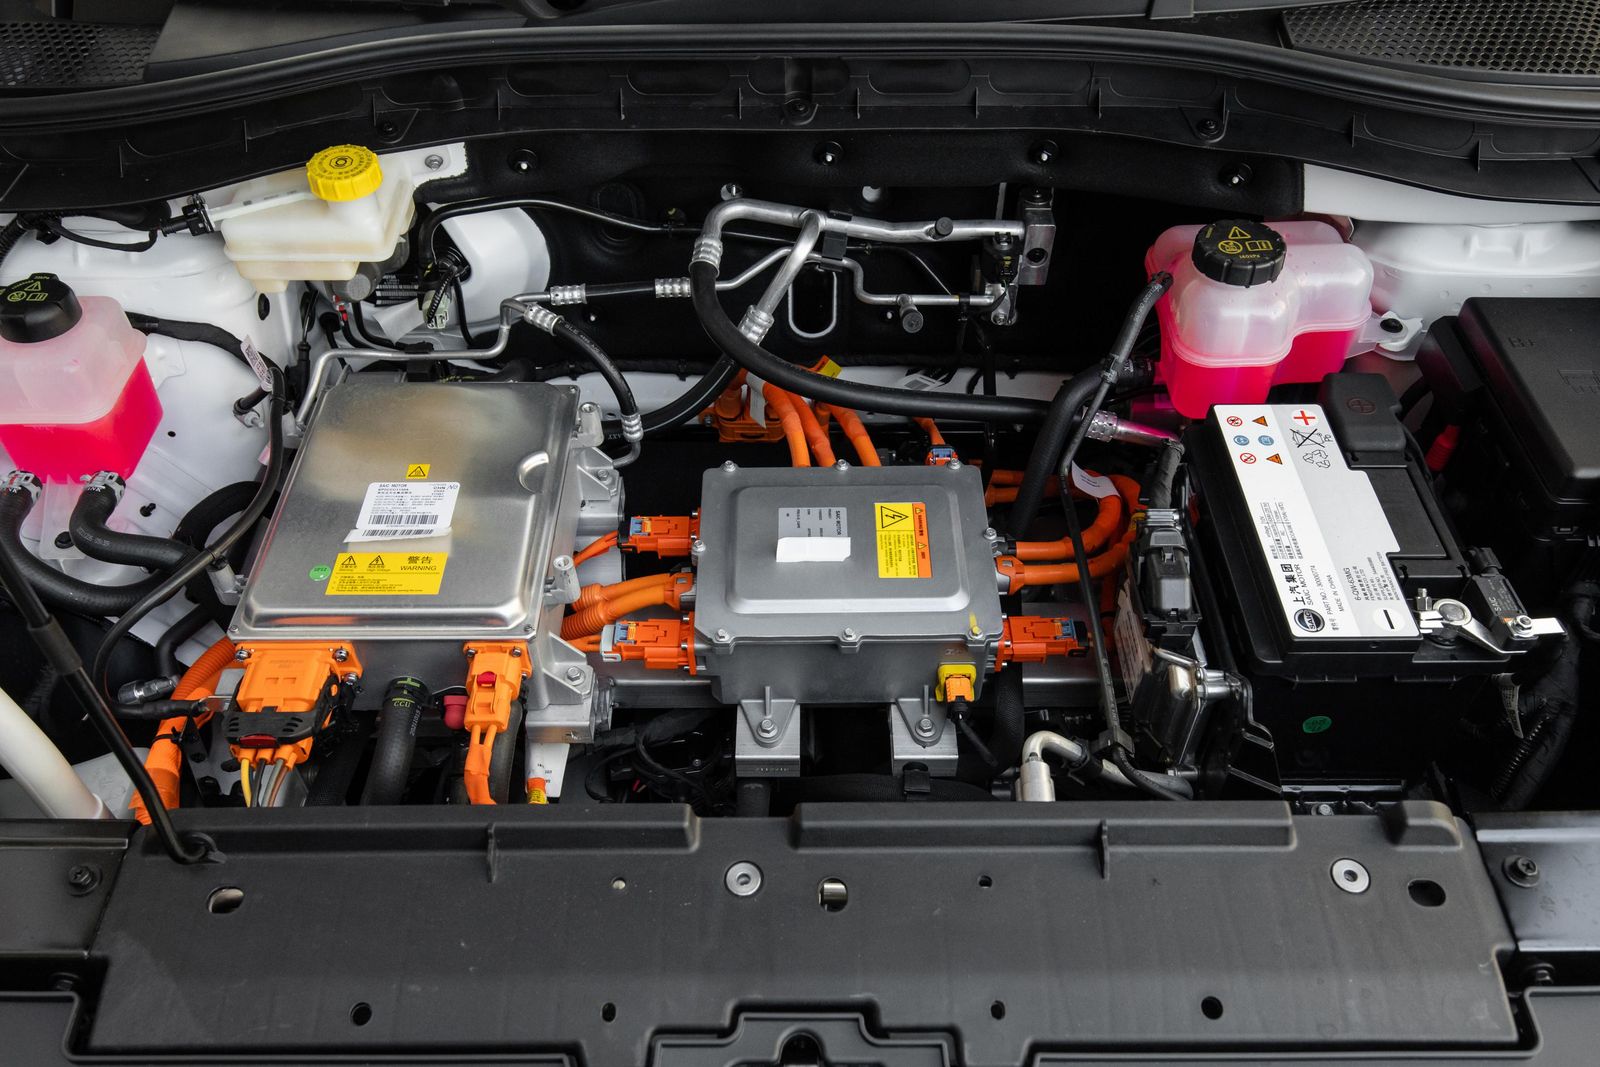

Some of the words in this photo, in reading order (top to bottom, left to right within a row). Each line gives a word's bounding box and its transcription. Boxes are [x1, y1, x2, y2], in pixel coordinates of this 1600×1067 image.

[408, 556, 432, 564] 警告
[1280, 564, 1306, 605] 上汽集团
[1294, 564, 1307, 588] MOTOR
[1326, 574, 1336, 589] CHINA
[1302, 589, 1314, 606] SAIC
[1323, 602, 1333, 615] PART
[1304, 611, 1315, 630] SAIC
